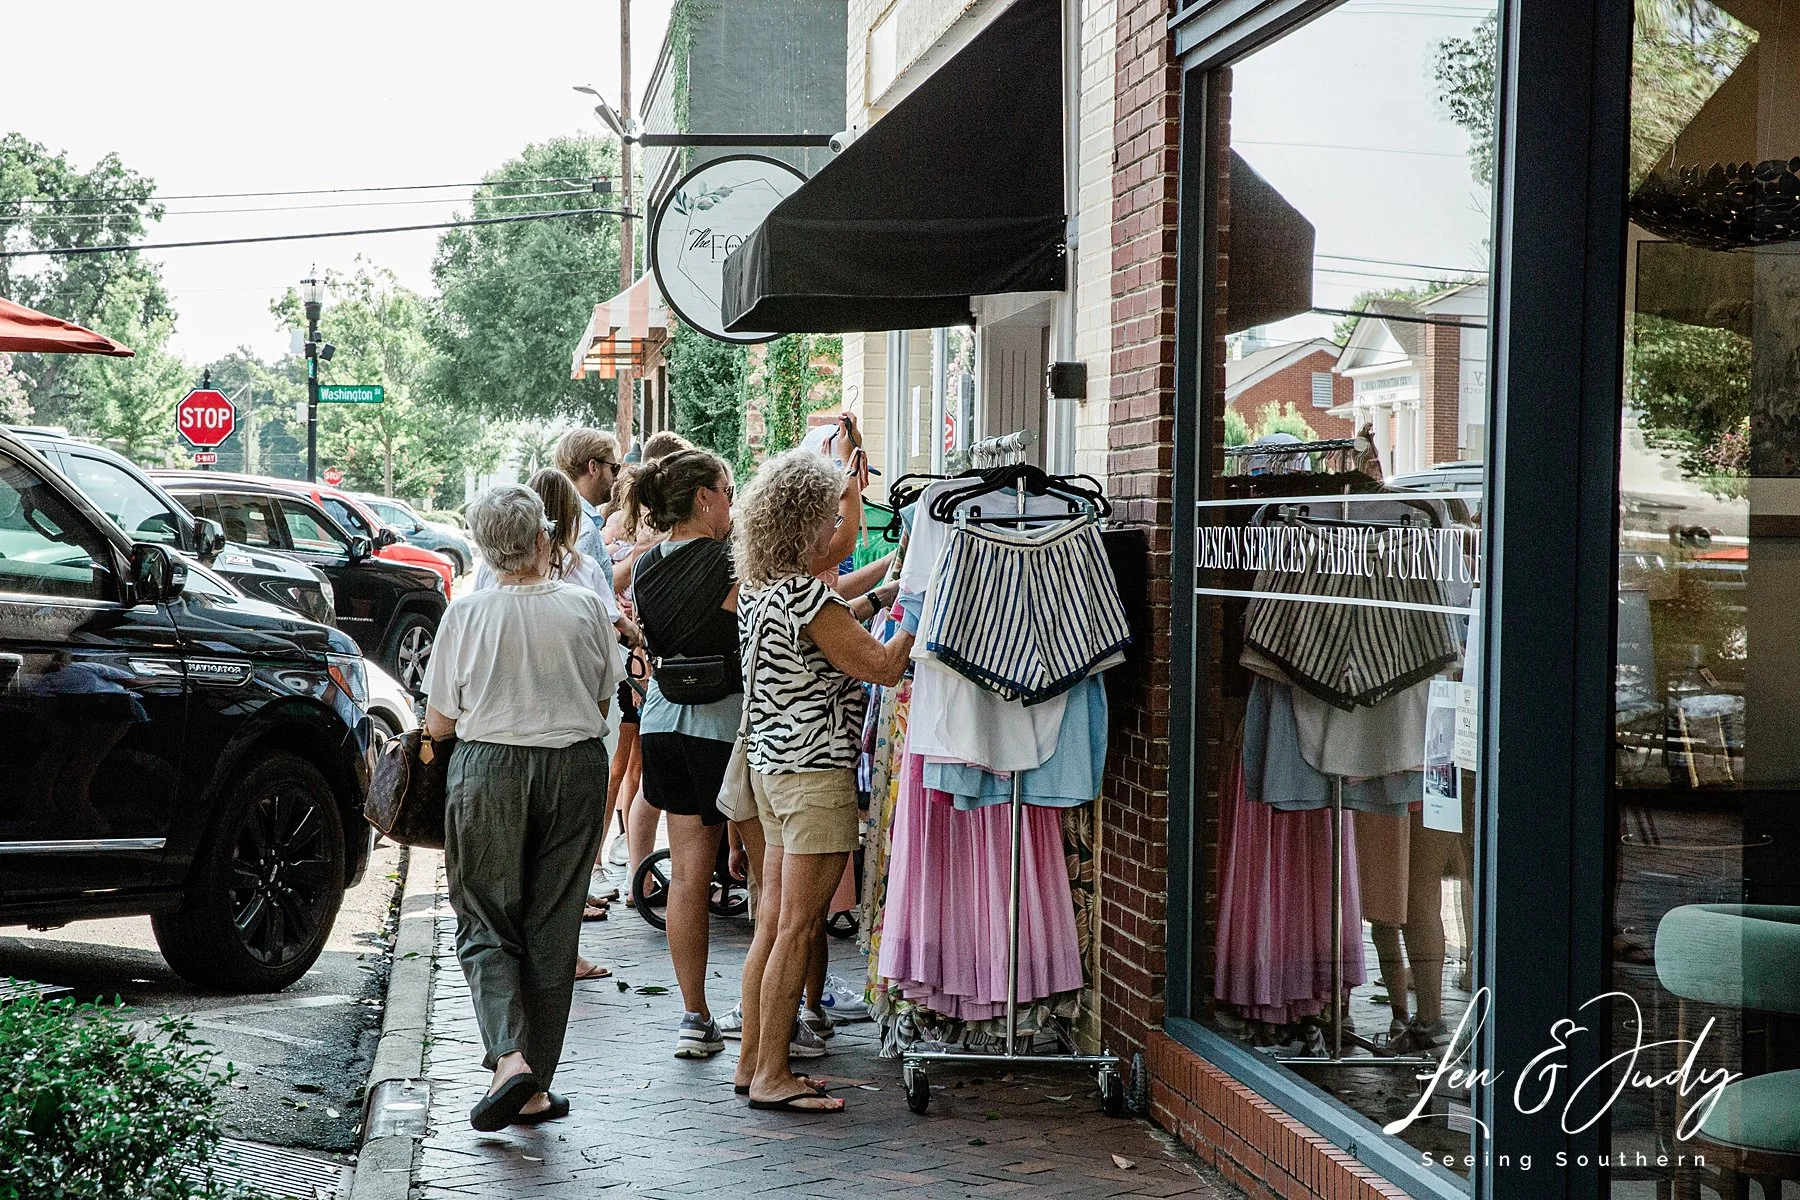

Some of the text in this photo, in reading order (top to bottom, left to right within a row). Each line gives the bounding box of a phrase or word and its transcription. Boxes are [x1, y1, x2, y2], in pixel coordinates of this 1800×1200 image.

[688, 227, 749, 259] The FO
[320, 388, 373, 402] Washington
[181, 407, 231, 429] STOP
[1195, 526, 1241, 569] DESIGN
[1242, 526, 1307, 573] SERVICES
[1316, 526, 1376, 577] FABRIC
[188, 663, 241, 673] NAVIGATOR
